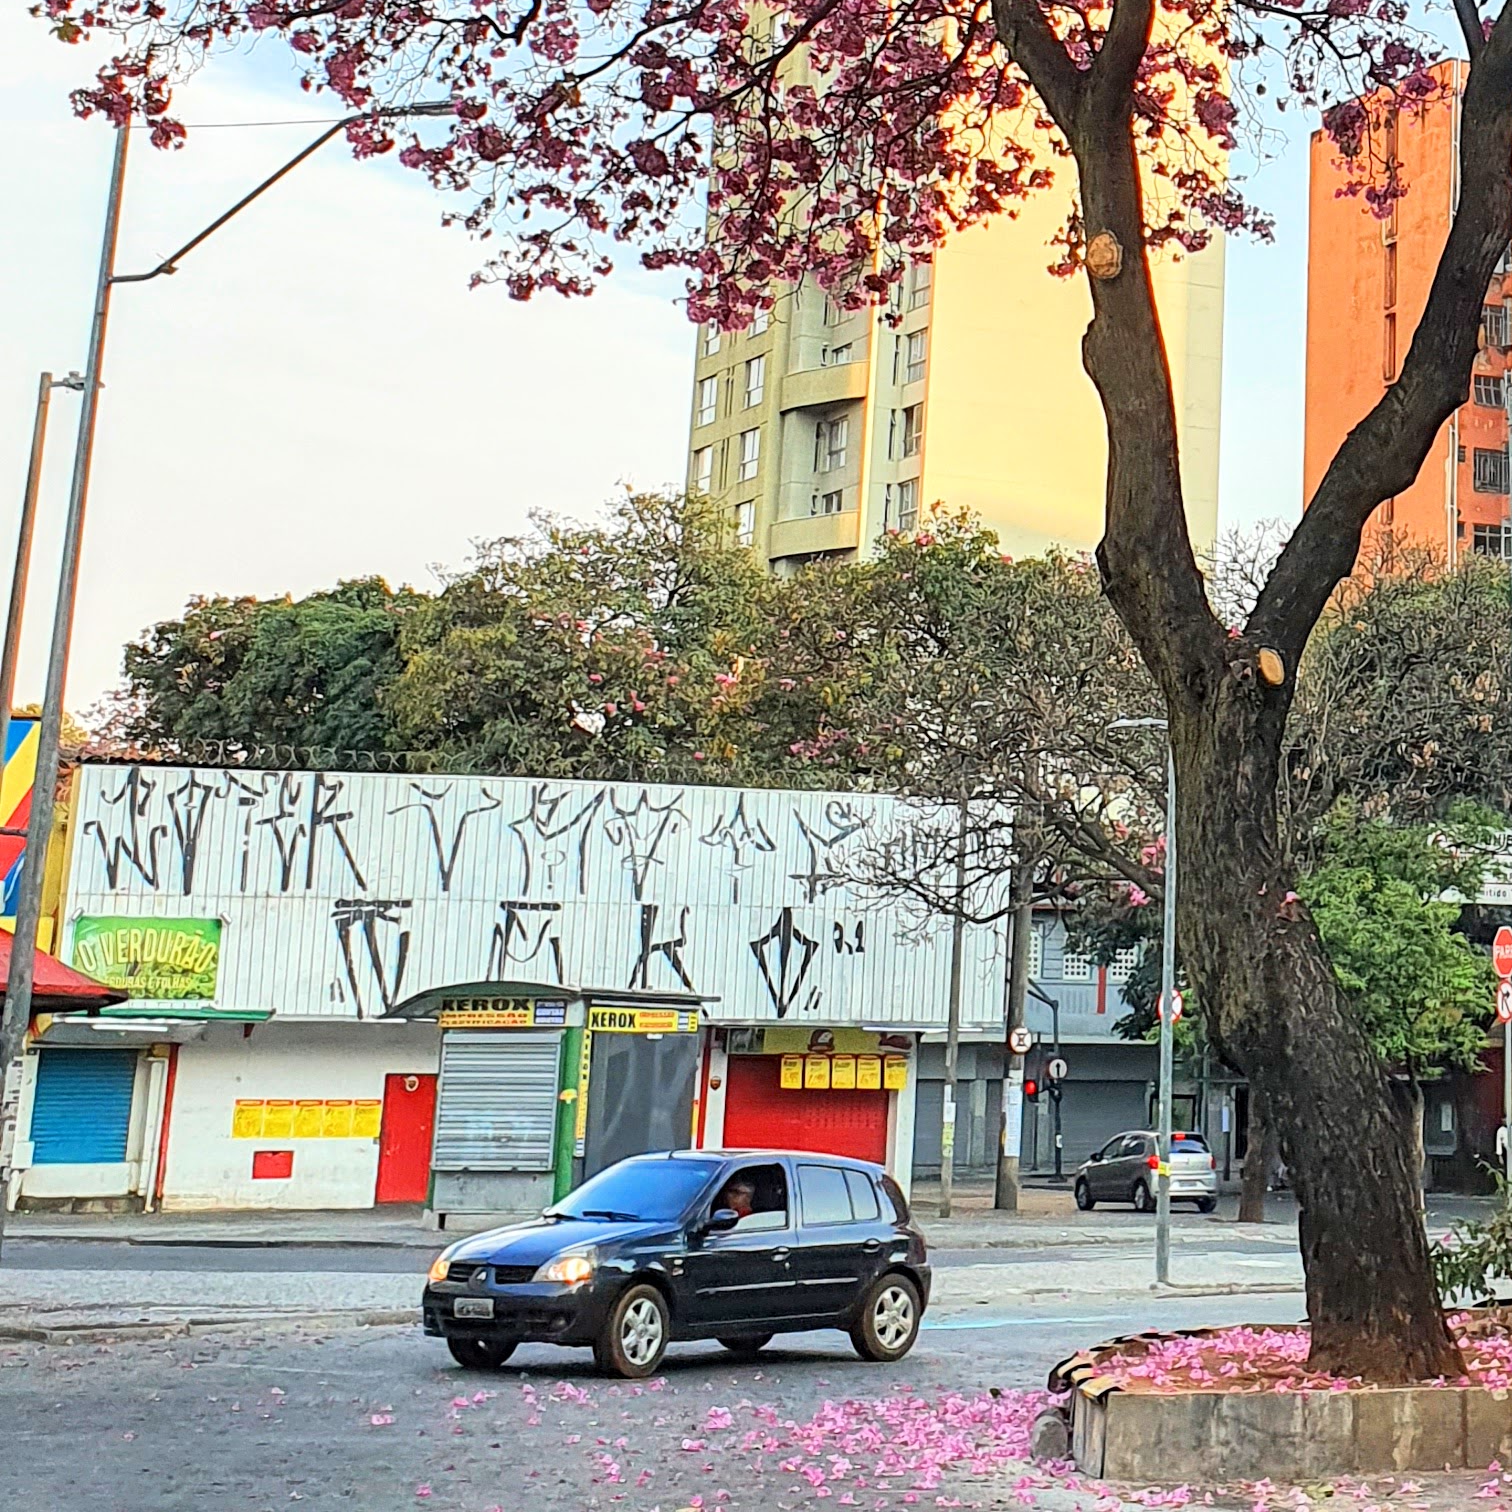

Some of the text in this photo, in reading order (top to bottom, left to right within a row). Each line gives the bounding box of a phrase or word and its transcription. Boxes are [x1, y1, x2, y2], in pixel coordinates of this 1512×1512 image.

[77, 928, 217, 973] O VERDURÃO
[592, 1012, 636, 1028] XEROX
